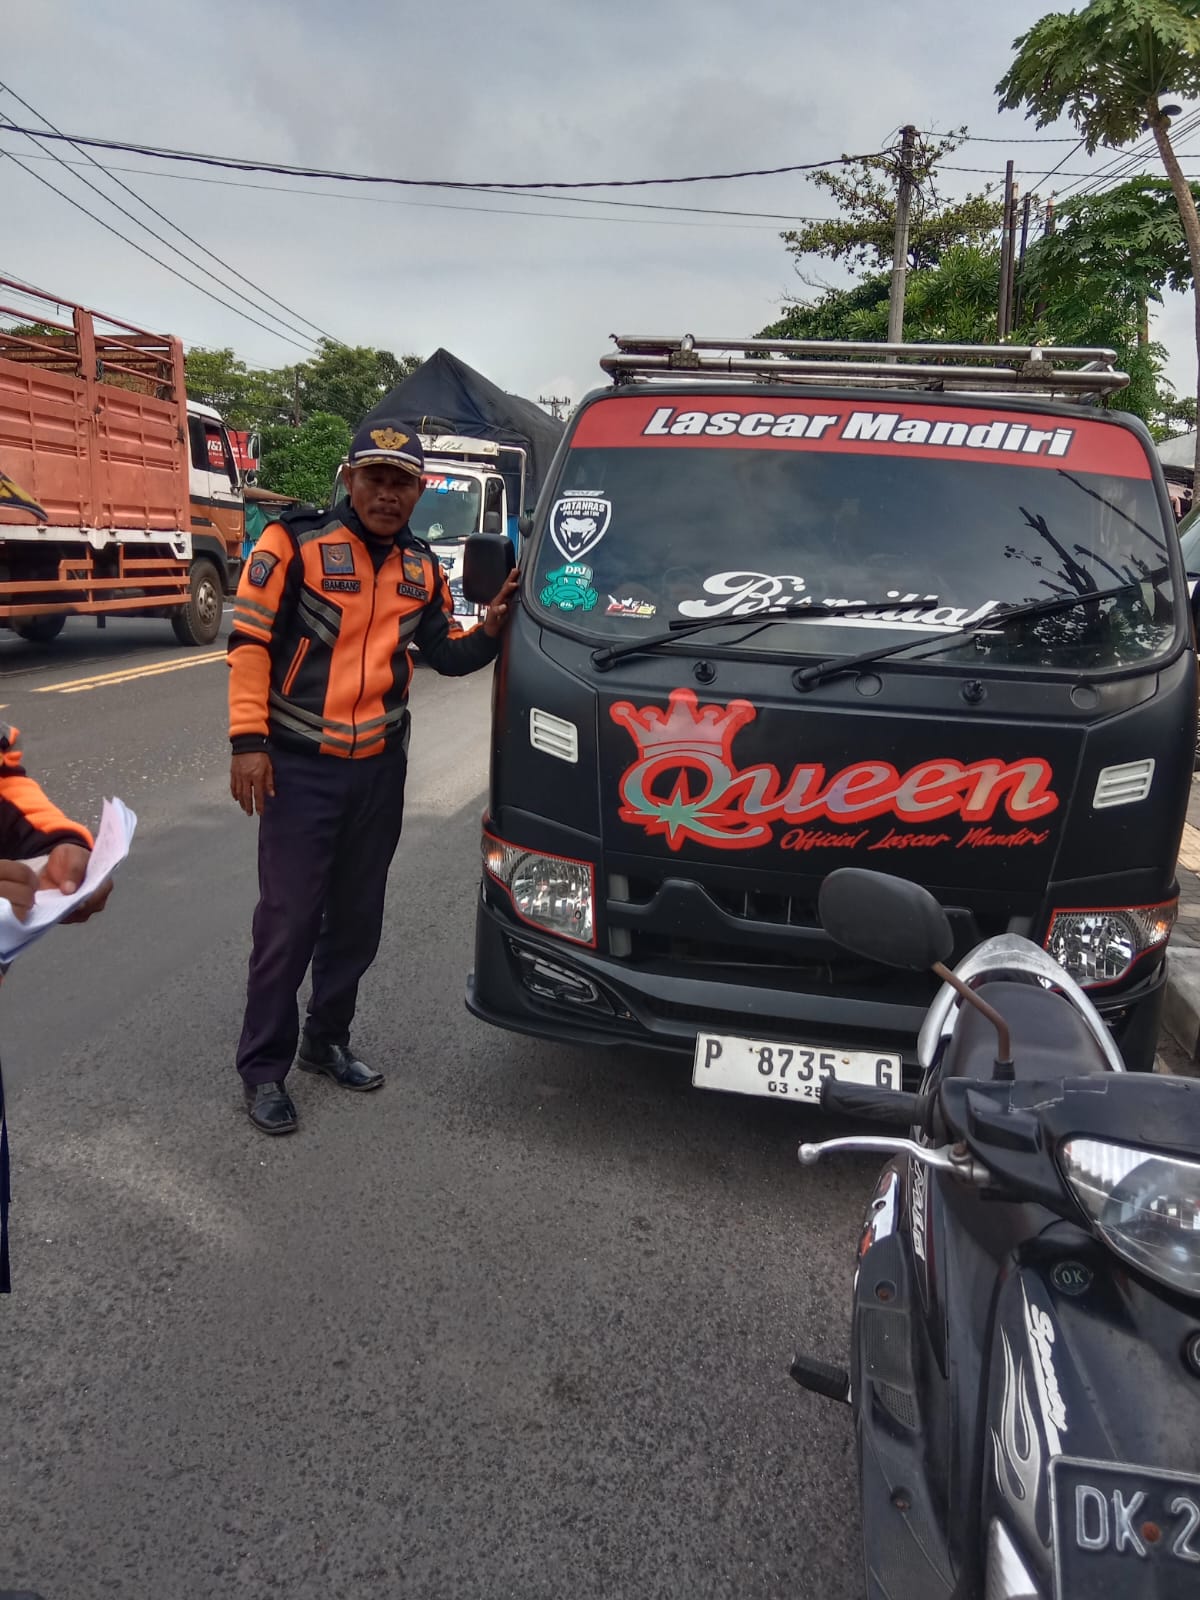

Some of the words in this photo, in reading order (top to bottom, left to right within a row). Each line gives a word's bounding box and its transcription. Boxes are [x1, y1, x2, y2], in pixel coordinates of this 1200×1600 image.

[643, 408, 838, 438] Lascar
[839, 412, 1076, 457] Mandiri
[560, 501, 605, 513] JATANRAS
[565, 565, 587, 575] DPJ
[324, 580, 359, 592] BAMBANG
[618, 751, 1058, 851] Queen
[780, 828, 869, 851] Official
[868, 828, 951, 850] Lascar
[956, 826, 1049, 848] Mandiri
[705, 1039, 722, 1068] P
[757, 1047, 837, 1081] 8735
[875, 1058, 893, 1090] G
[1061, 1270, 1084, 1284] OK
[1075, 1484, 1147, 1557] DK
